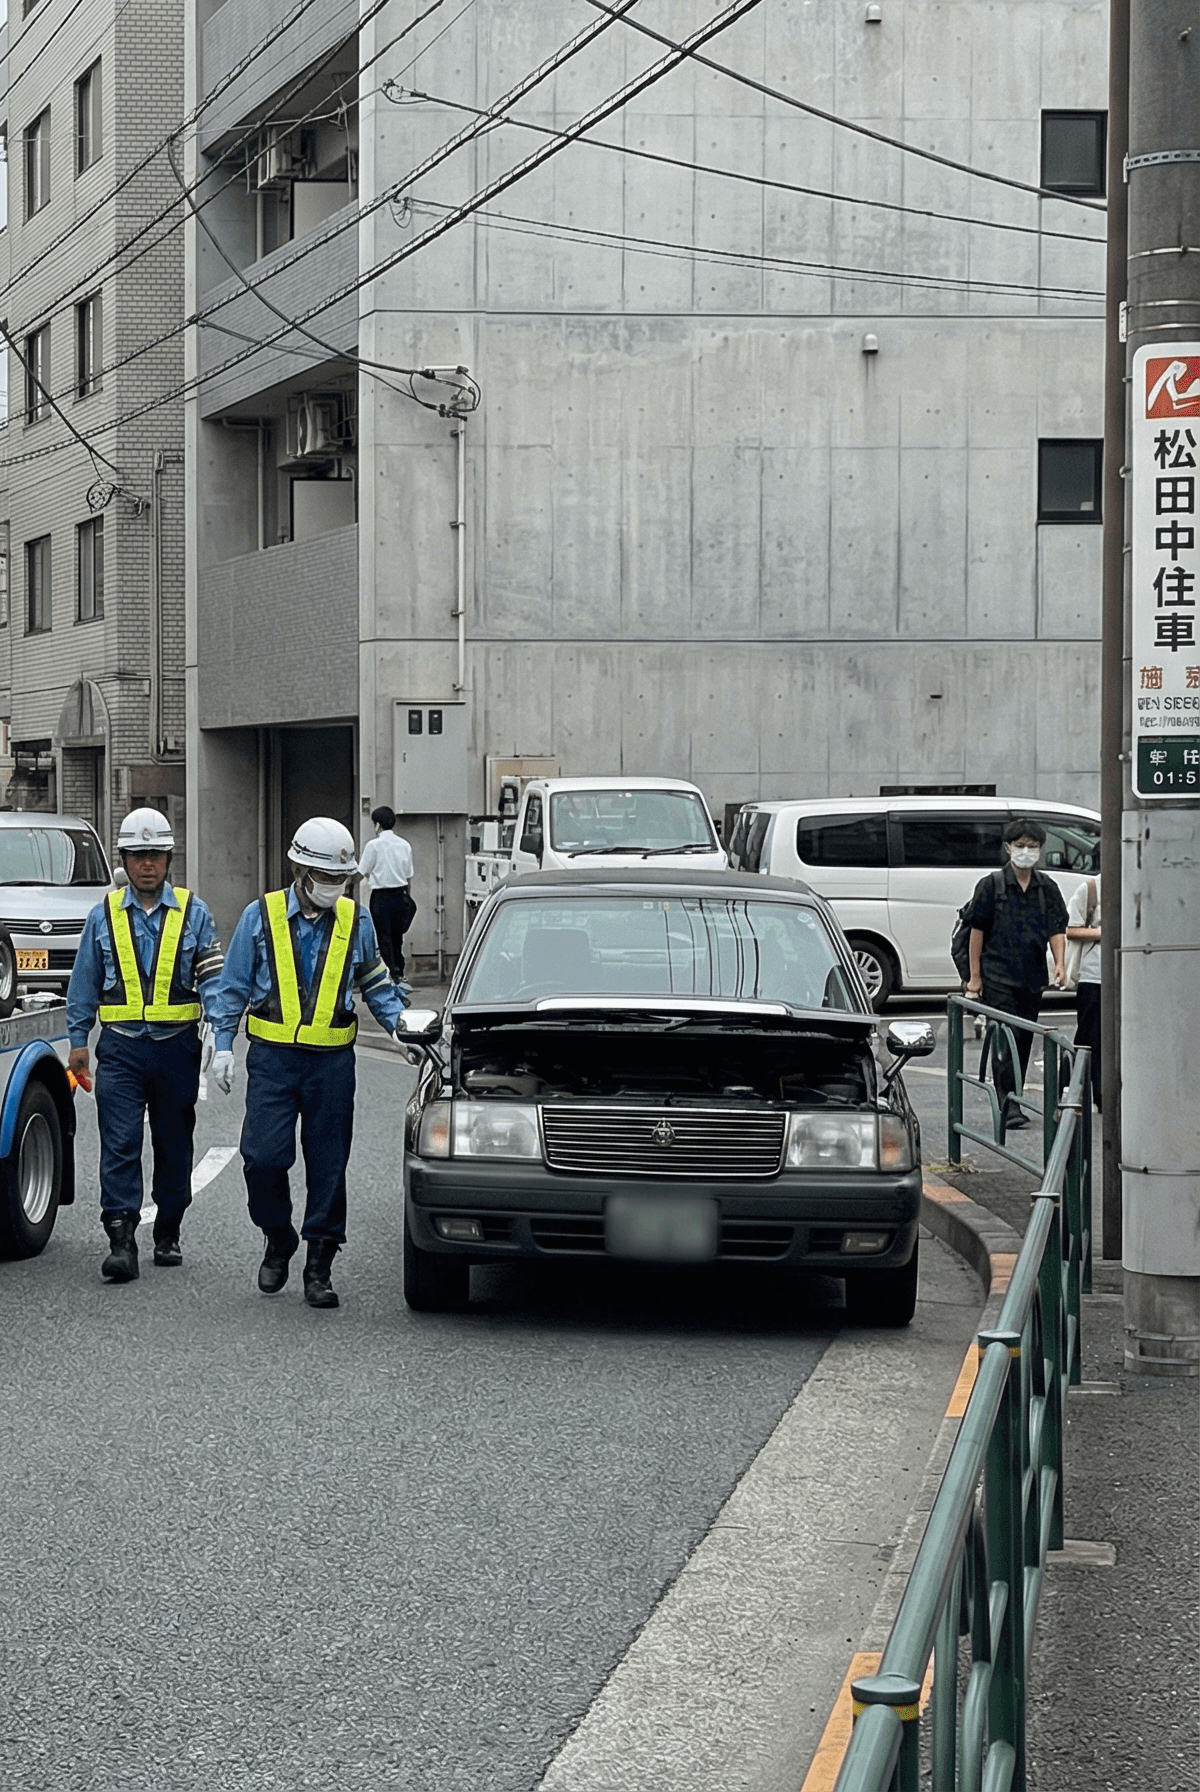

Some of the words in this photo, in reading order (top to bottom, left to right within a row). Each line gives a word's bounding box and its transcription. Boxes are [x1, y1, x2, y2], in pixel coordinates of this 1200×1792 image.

[1153, 428, 1197, 653] 松田中住車
